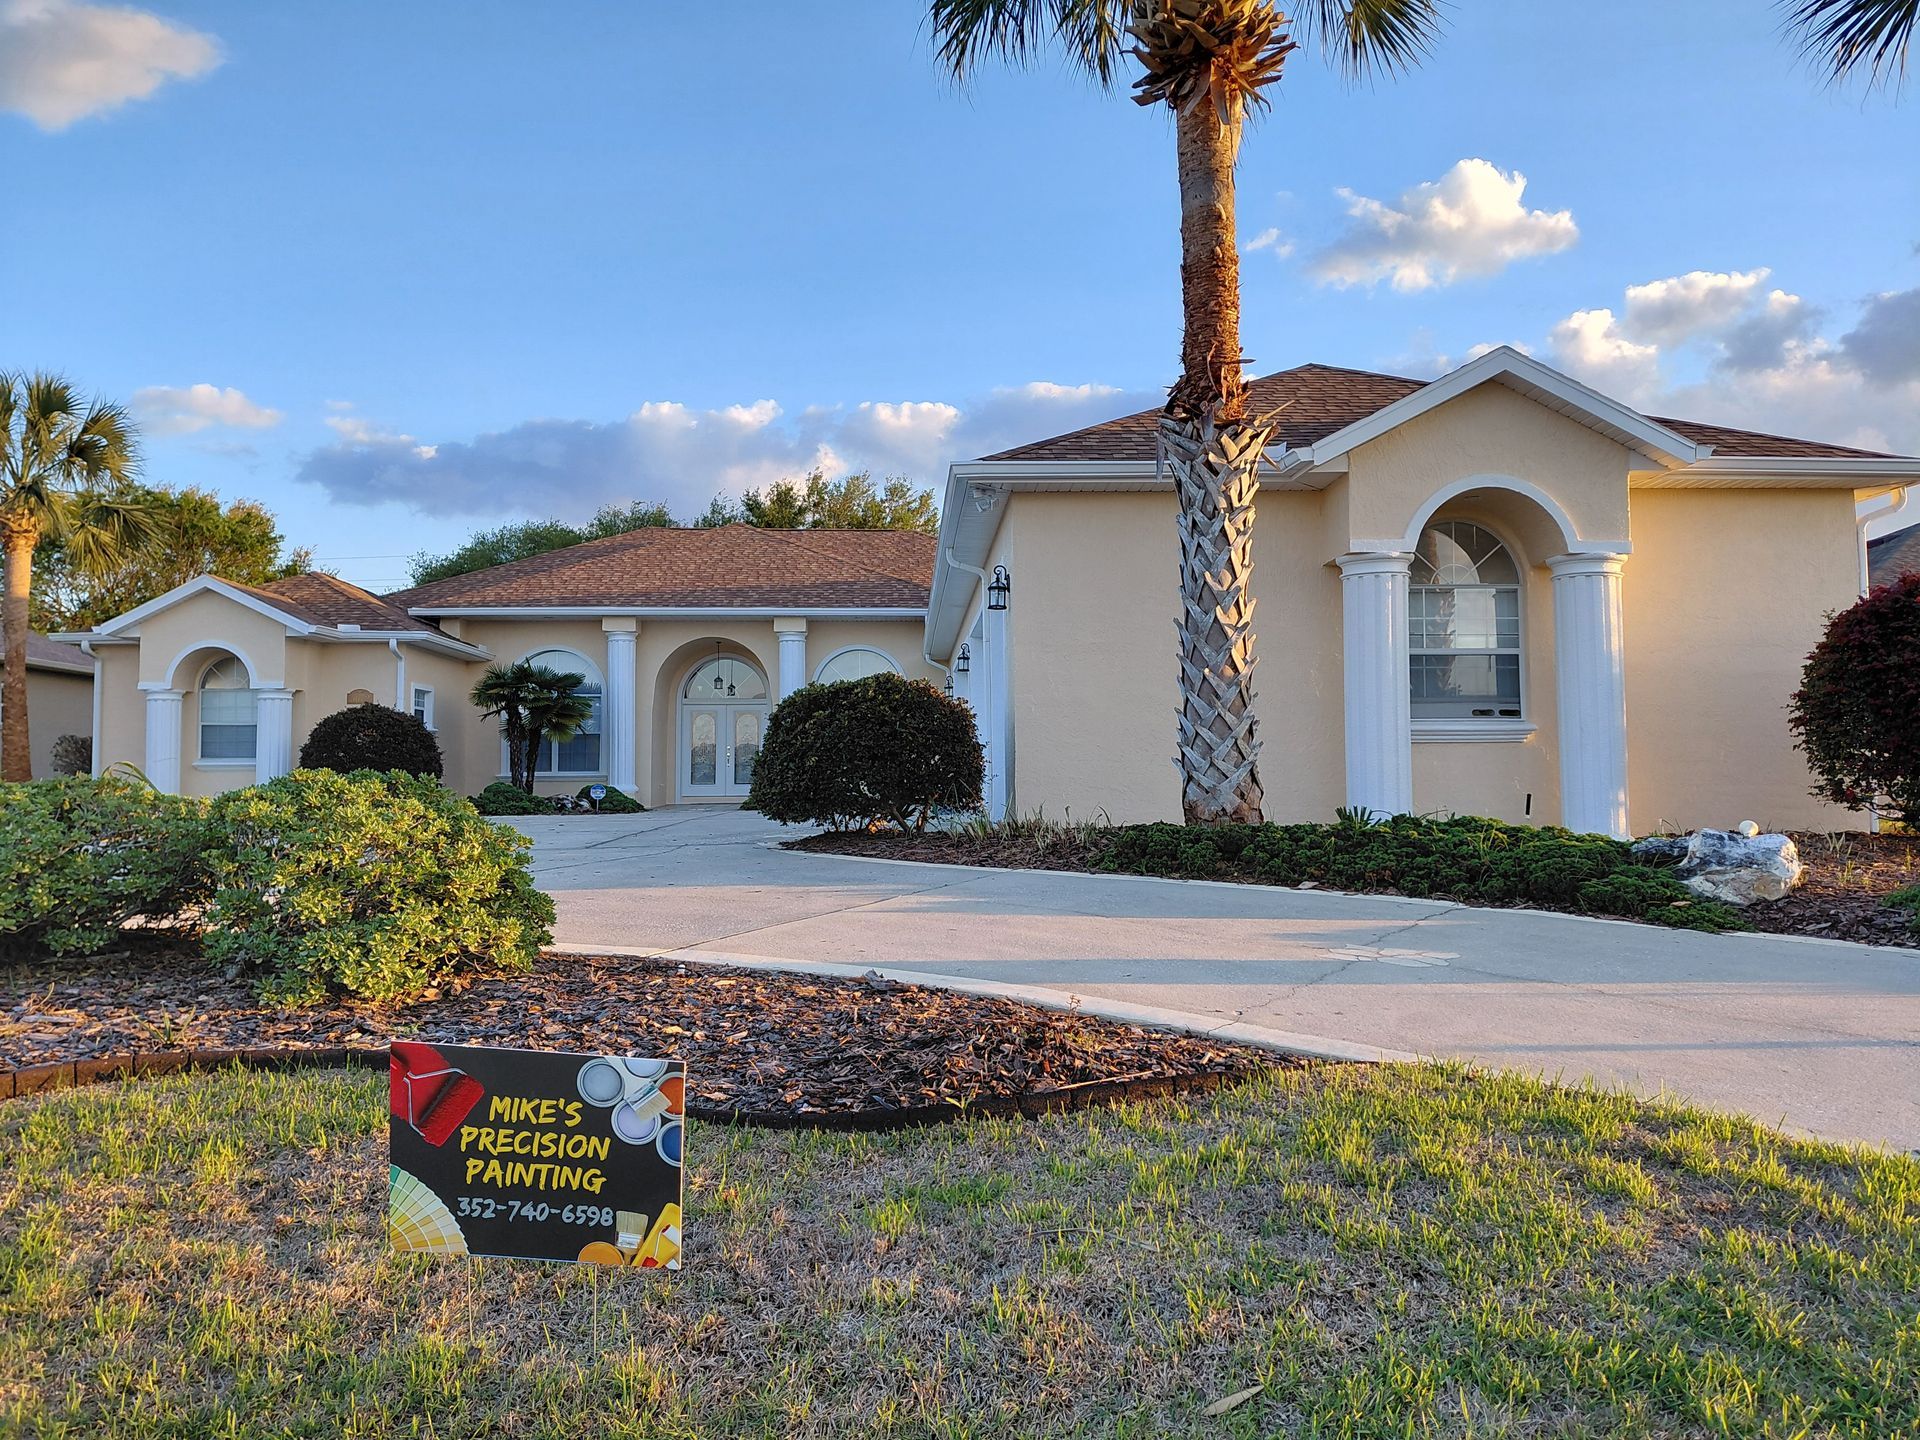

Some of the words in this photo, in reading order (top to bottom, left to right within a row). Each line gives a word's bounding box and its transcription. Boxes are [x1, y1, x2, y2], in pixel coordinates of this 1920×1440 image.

[489, 1095, 584, 1127] MIKE'S
[460, 1125, 611, 1161] PRECISION
[465, 1158, 607, 1194] PAINTING
[457, 1197, 614, 1227] 352-740-6598
